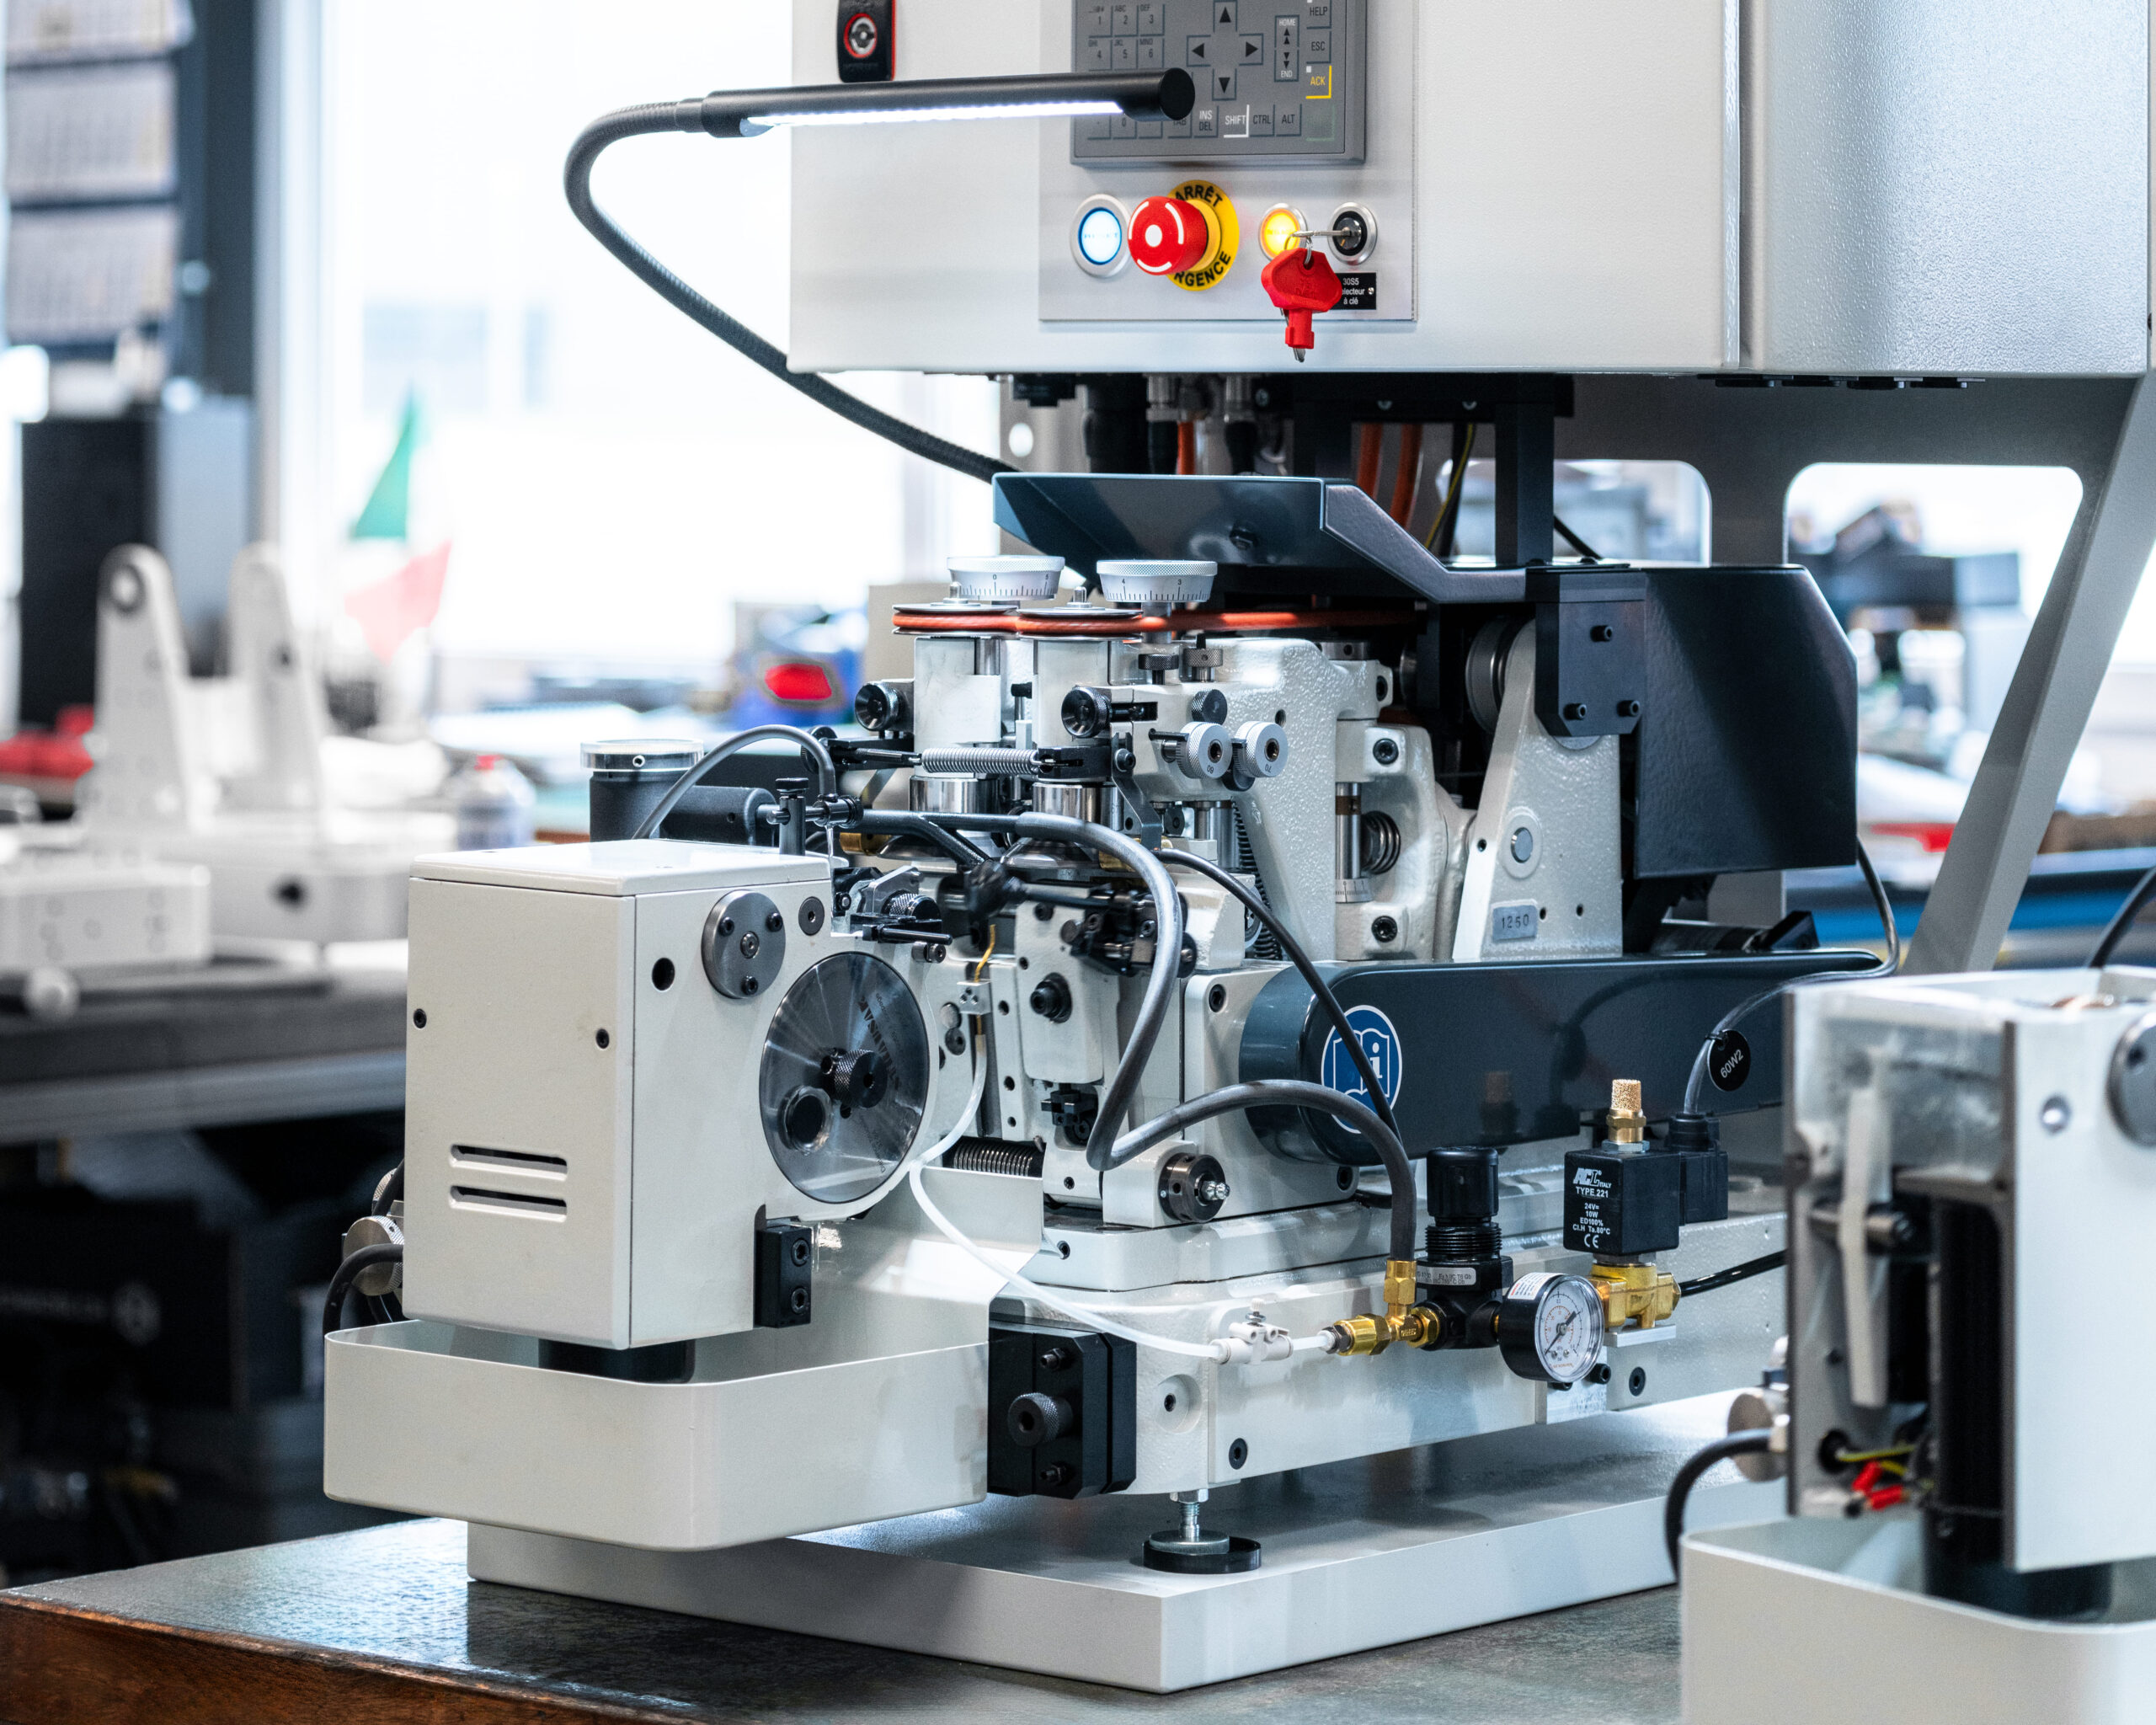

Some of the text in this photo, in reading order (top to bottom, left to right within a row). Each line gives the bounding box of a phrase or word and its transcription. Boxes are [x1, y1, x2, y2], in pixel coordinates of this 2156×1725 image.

[1310, 6, 1328, 16] HELP
[1123, 15, 1128, 24] 2
[1149, 14, 1154, 24] 3
[1310, 40, 1326, 51] ESC
[1123, 49, 1128, 59] 5
[1148, 48, 1153, 58] 6
[1310, 76, 1326, 86] ACK
[1199, 110, 1212, 120] INS
[1252, 115, 1272, 125] CTRL
[1281, 114, 1295, 124] ALT
[1225, 115, 1246, 126] SHIFT
[1199, 121, 1213, 131] DEL
[1175, 184, 1223, 207] ARRÊT
[1173, 251, 1231, 287] RGENCE
[1348, 296, 1358, 305] clé
[1502, 913, 1529, 929] 1250
[1720, 1049, 1744, 1079] 60W2
[1576, 1186, 1609, 1198] TYPE 221
